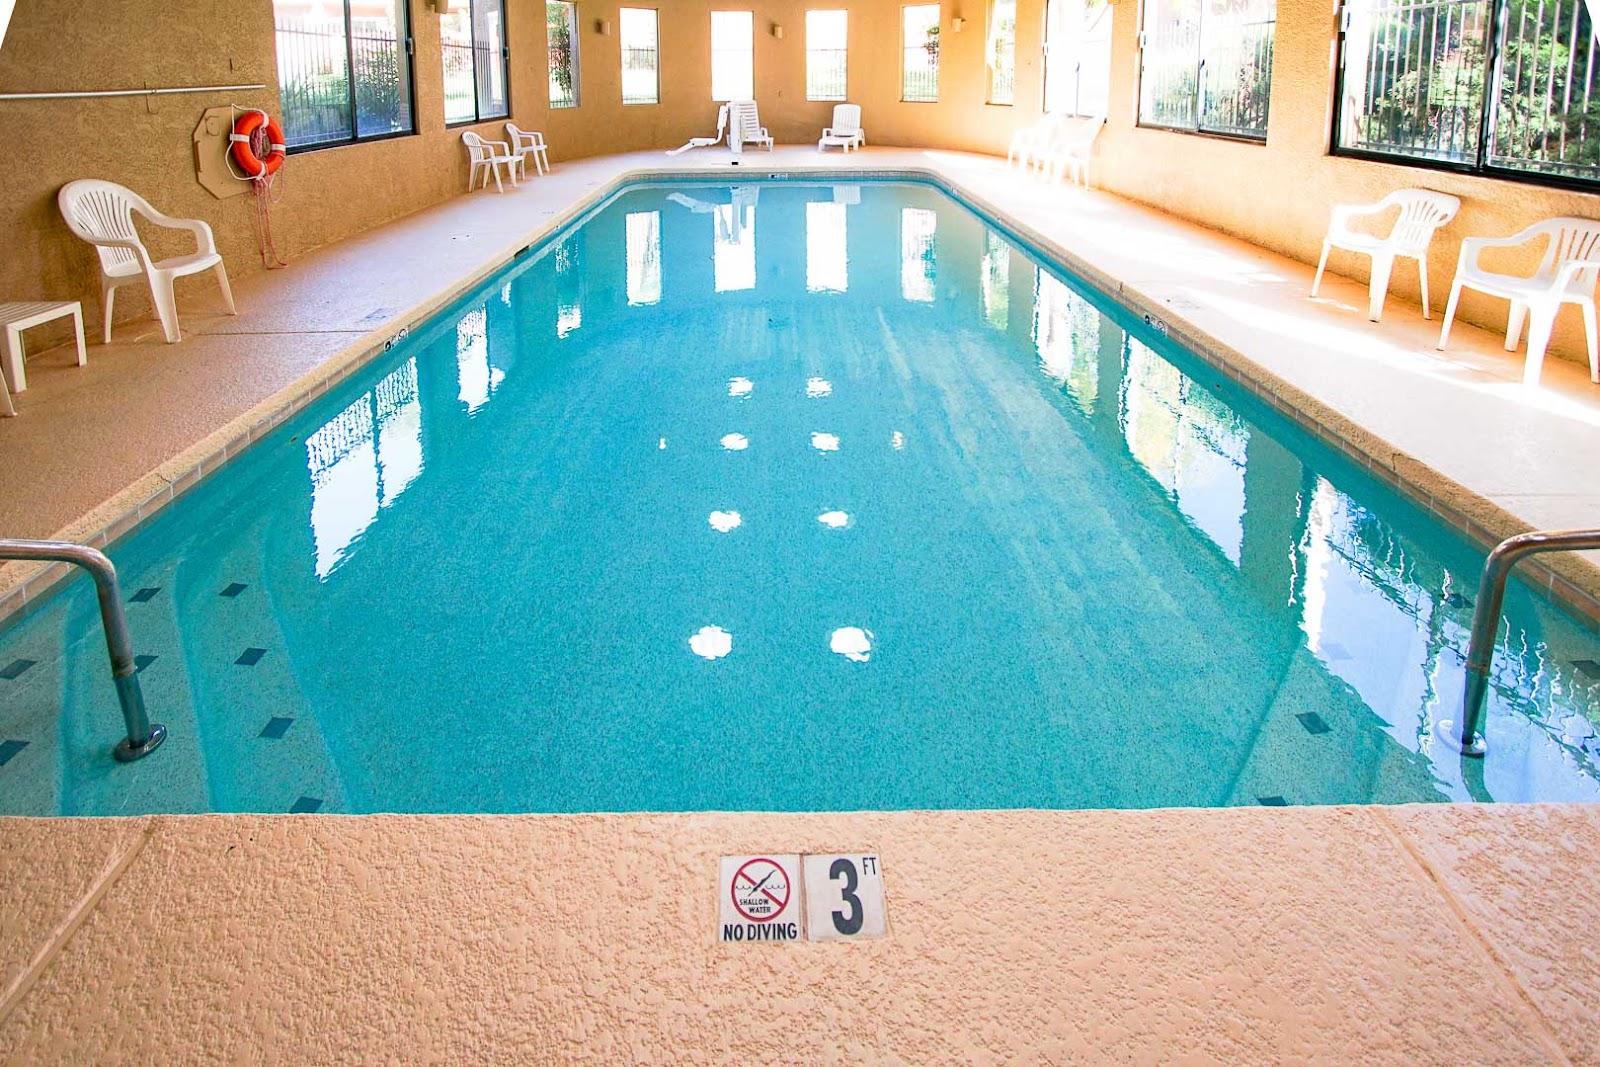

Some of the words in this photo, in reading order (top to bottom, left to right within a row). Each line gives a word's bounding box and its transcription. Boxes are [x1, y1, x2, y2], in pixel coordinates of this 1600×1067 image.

[739, 898, 769, 906] SHALLOW
[829, 858, 864, 936] 3
[862, 857, 877, 875] FT
[749, 906, 771, 914] WATER
[723, 924, 743, 941] NO
[747, 922, 798, 941] DIVING
